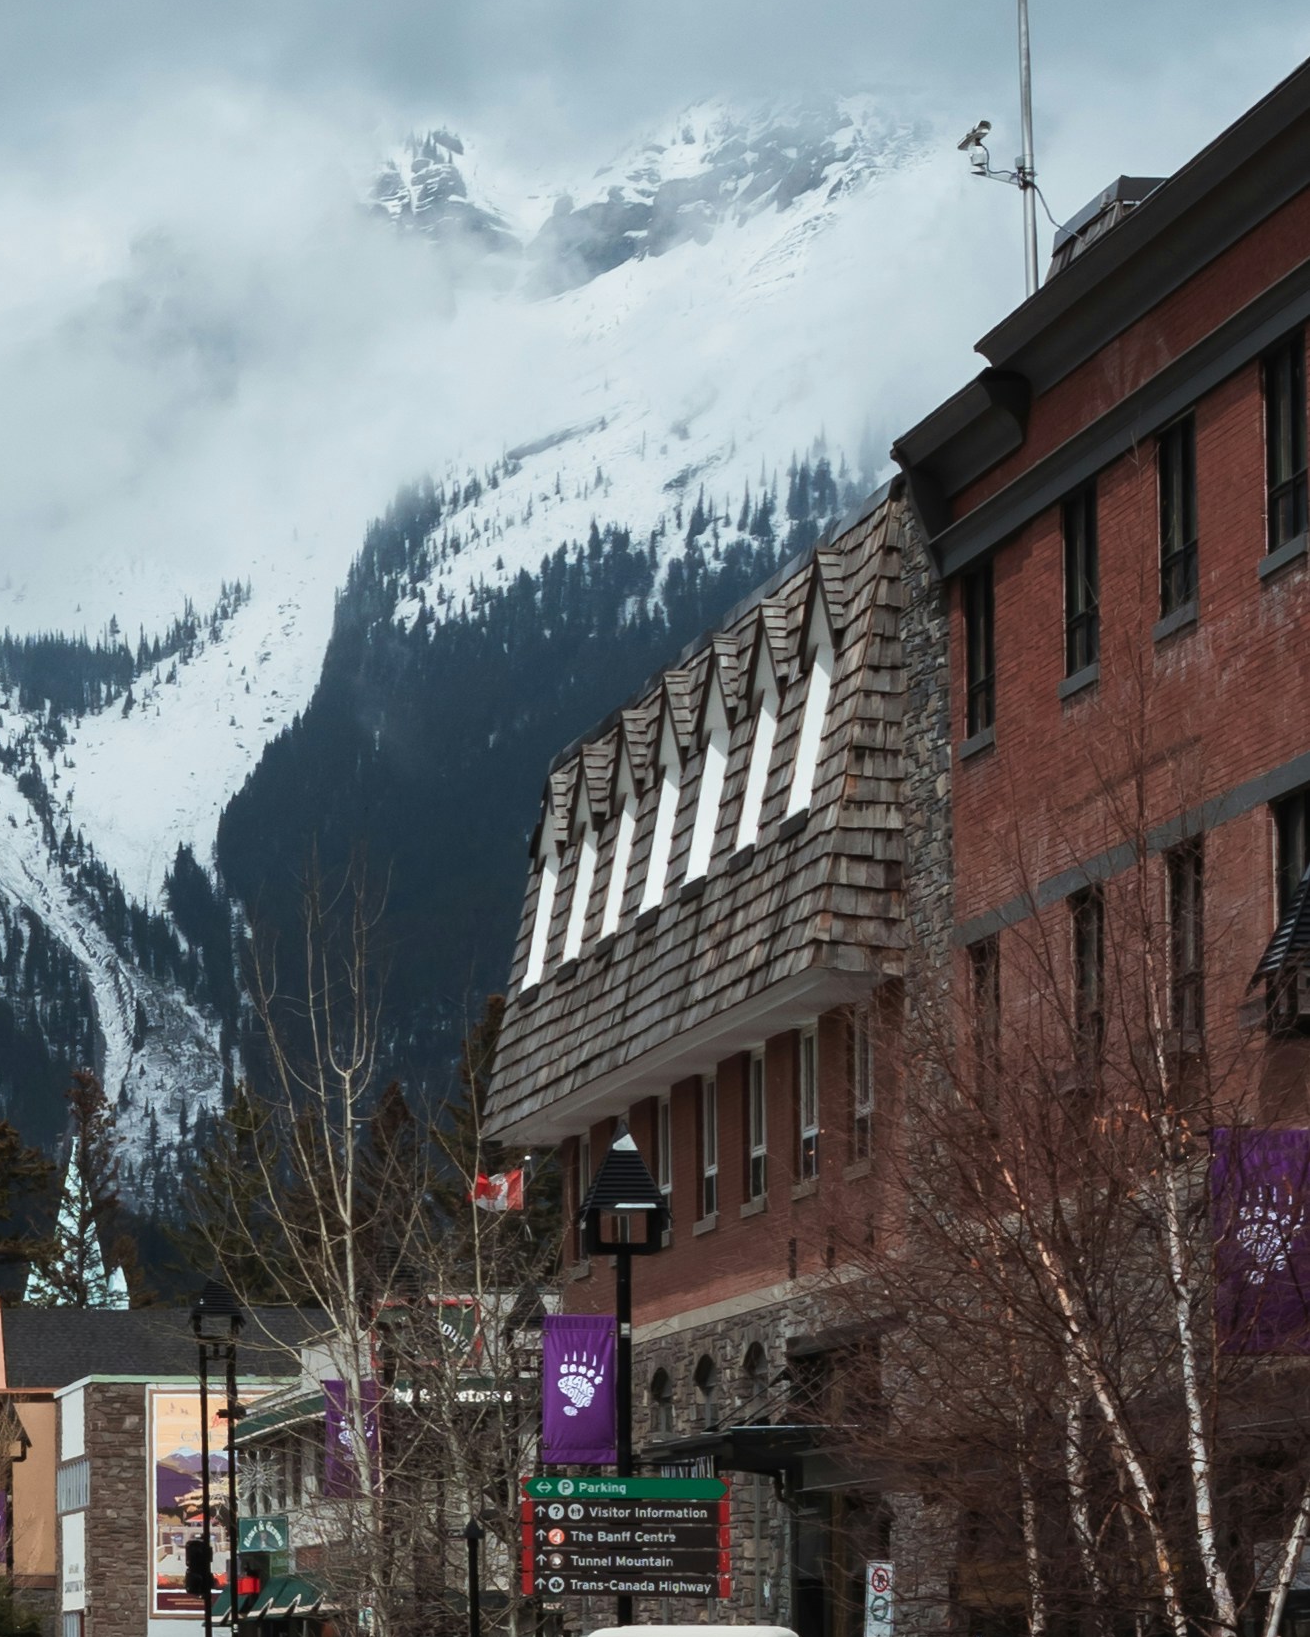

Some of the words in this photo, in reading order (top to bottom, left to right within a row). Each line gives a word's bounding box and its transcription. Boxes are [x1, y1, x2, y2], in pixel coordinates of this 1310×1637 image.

[579, 1481, 627, 1495] Parking
[589, 1507, 630, 1518] Visitor
[635, 1507, 708, 1518] Information
[570, 1531, 589, 1542] The
[597, 1531, 630, 1542] Banff
[634, 1531, 676, 1543] Centre
[570, 1555, 612, 1567] Tunnel
[616, 1556, 674, 1567] Mountain
[570, 1579, 655, 1592] Trans-Canada
[659, 1580, 712, 1594] Highway
